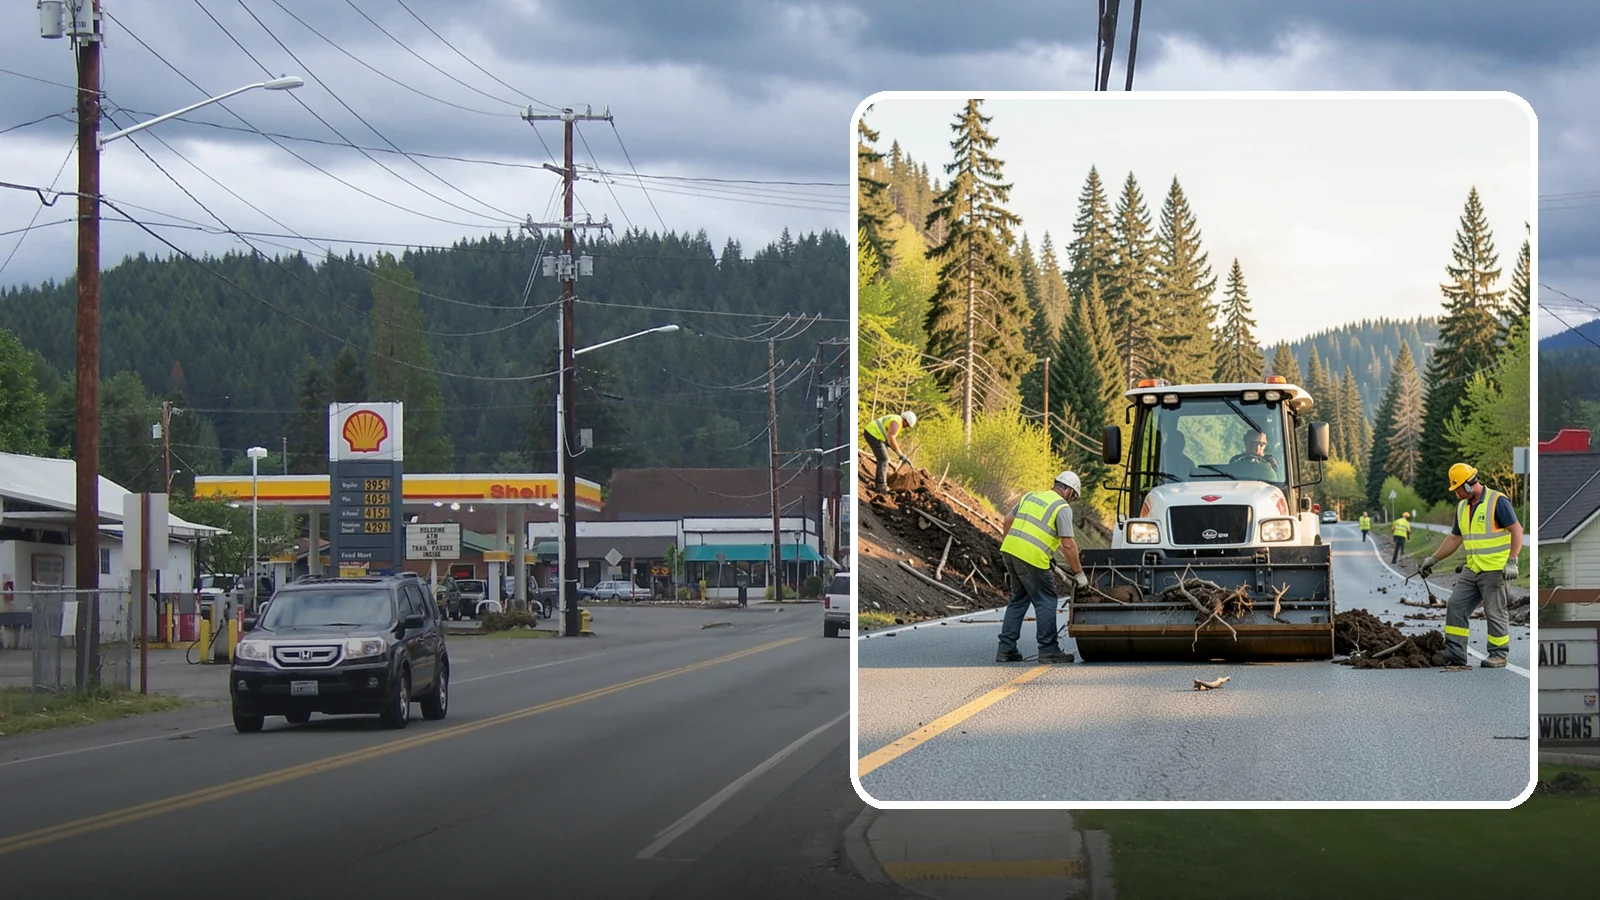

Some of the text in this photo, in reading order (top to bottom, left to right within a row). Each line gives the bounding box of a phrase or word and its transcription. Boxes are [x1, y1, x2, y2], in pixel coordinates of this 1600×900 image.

[366, 480, 383, 490] 395
[490, 484, 547, 499] Shell
[366, 494, 383, 504] 405
[366, 508, 383, 518] 415
[366, 522, 383, 532] 429
[1538, 643, 1567, 665] AID
